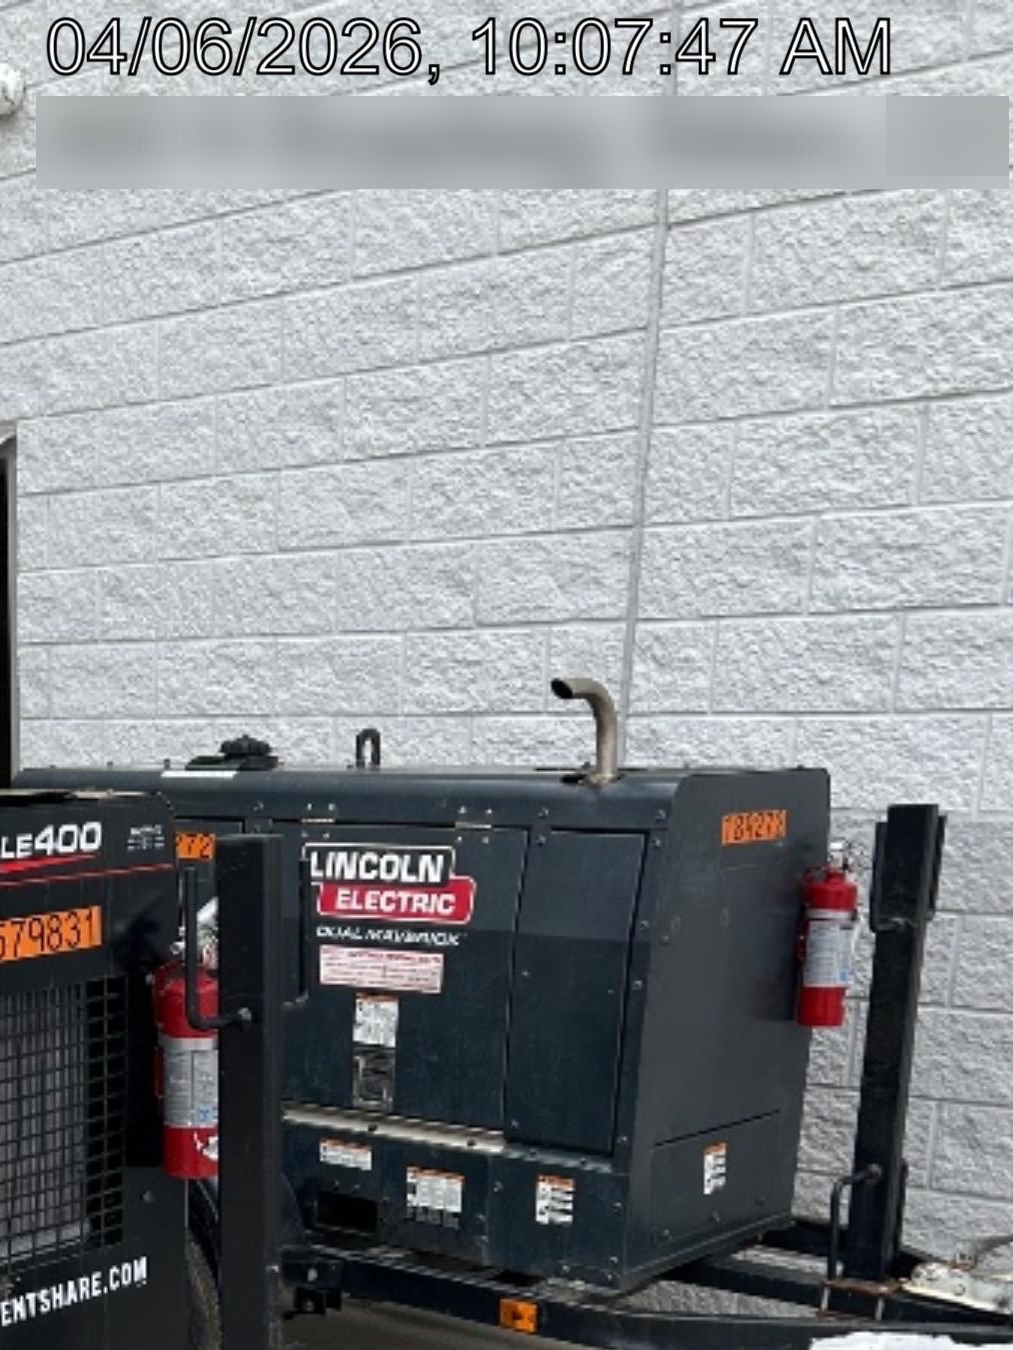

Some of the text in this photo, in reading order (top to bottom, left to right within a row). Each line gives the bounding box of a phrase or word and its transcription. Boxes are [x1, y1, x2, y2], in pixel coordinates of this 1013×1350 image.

[0, 821, 103, 860] LE400
[309, 851, 445, 883] LINCOLN
[334, 889, 457, 915] ELECTRIC
